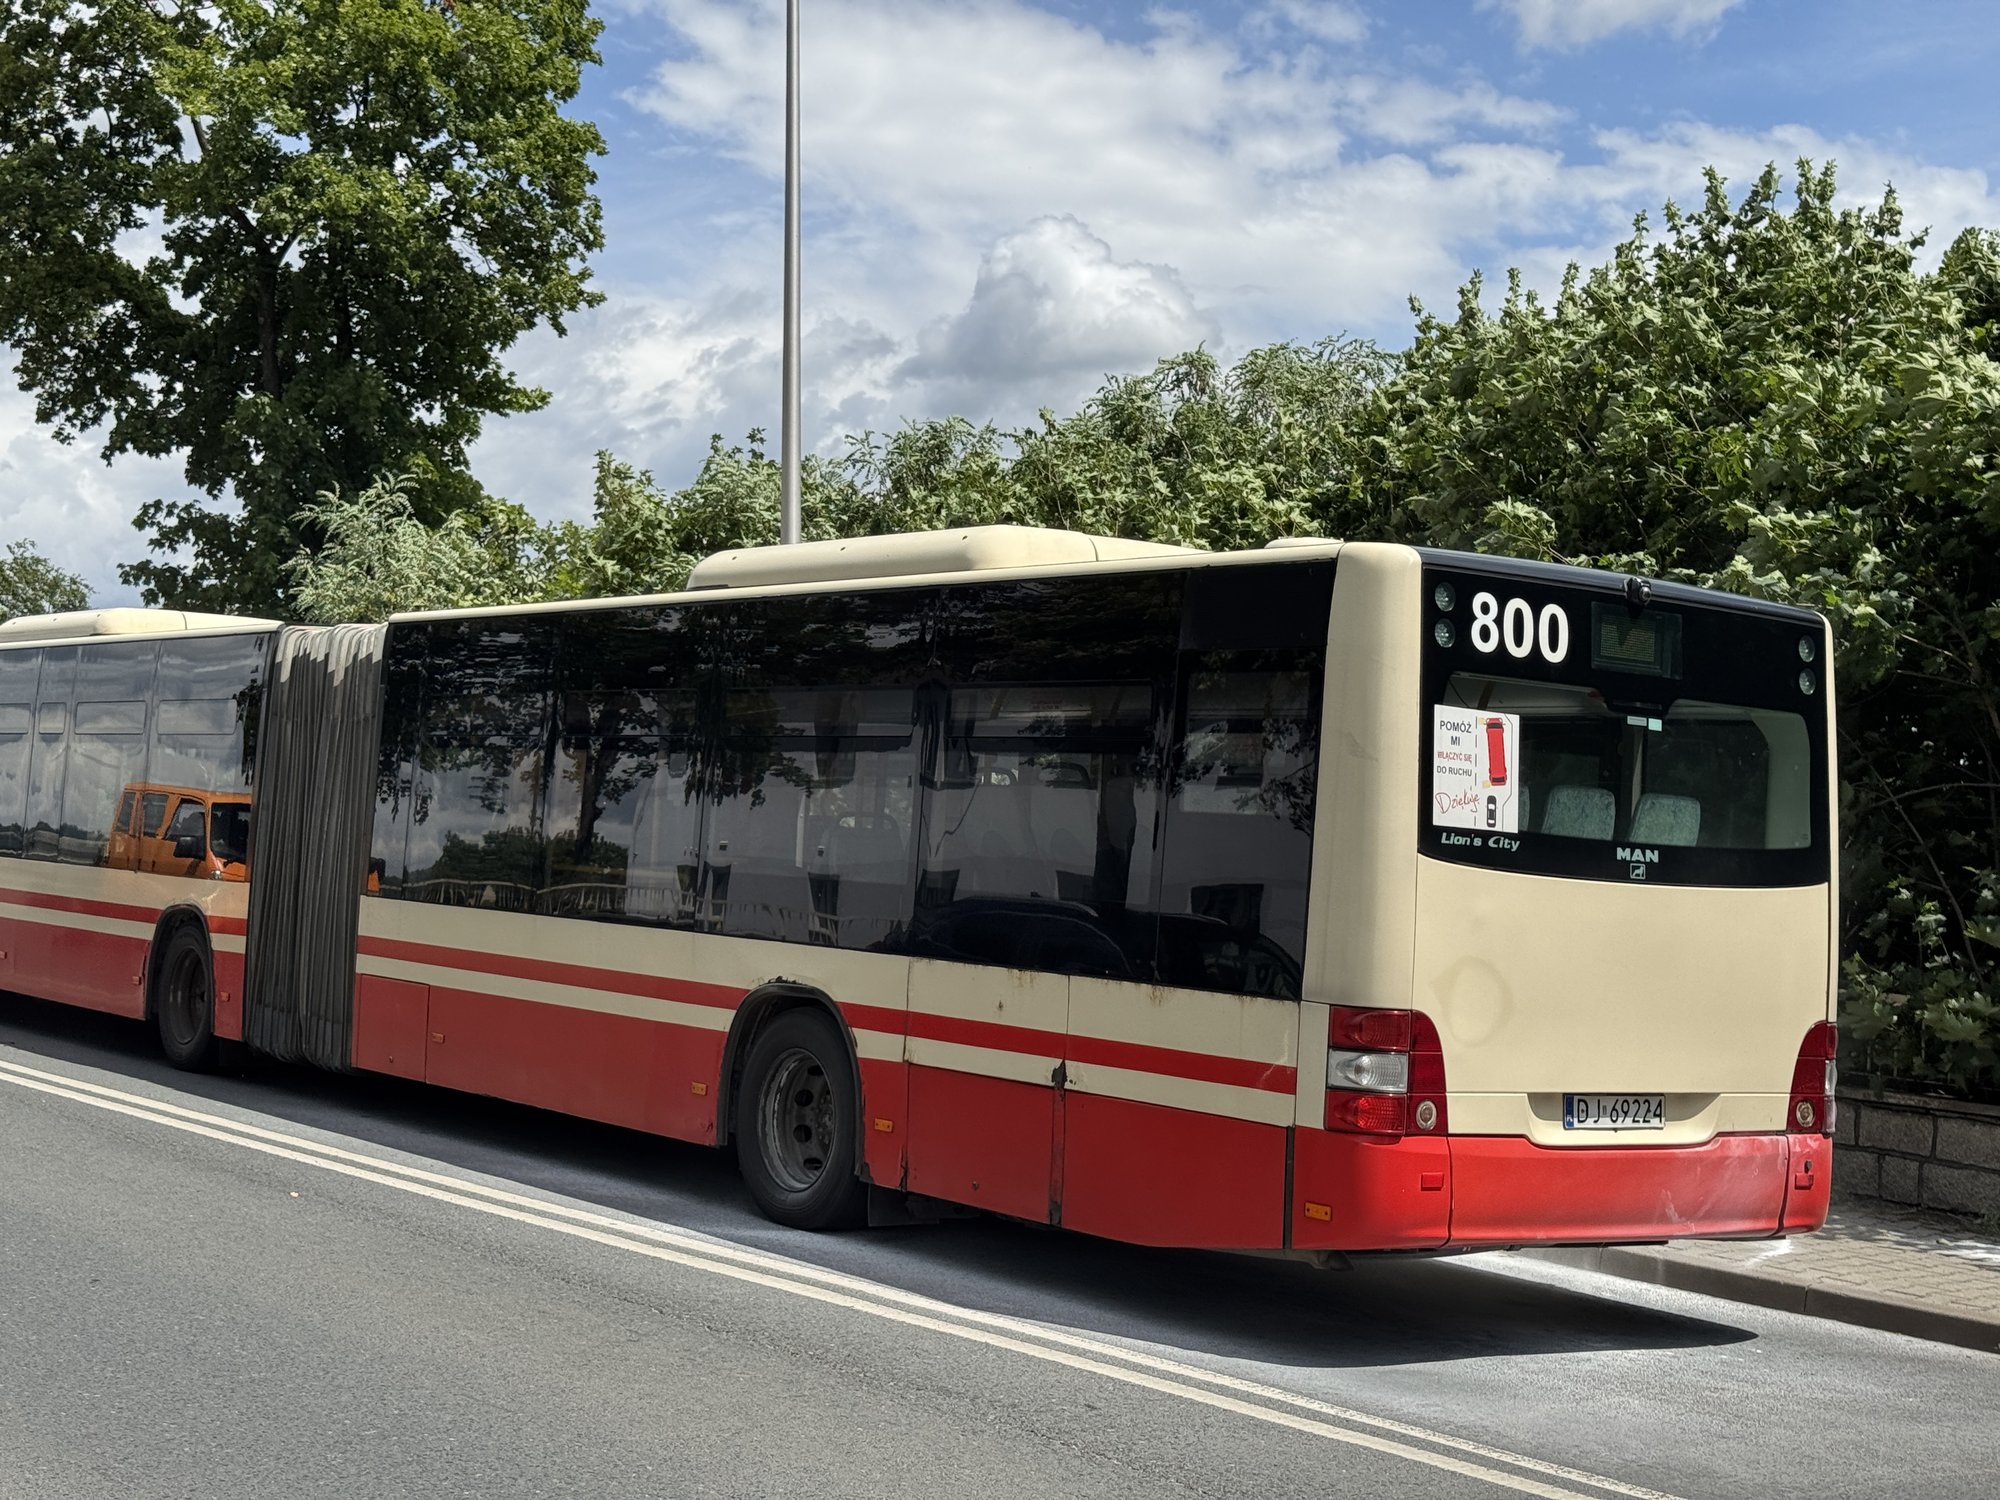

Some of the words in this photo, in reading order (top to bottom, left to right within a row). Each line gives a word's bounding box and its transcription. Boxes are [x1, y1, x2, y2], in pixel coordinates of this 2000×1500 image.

[1471, 592, 1569, 663] 800
[1440, 720, 1472, 733] POMÓŻ
[1450, 735, 1461, 746] MI
[1436, 765, 1447, 774] DO
[1448, 766, 1473, 776] RUCHU
[1441, 832, 1482, 847] Lion's
[1488, 836, 1520, 852] City
[1616, 847, 1659, 863] MAN
[1577, 1098, 1600, 1123] DJ
[1610, 1098, 1663, 1124] 69224
